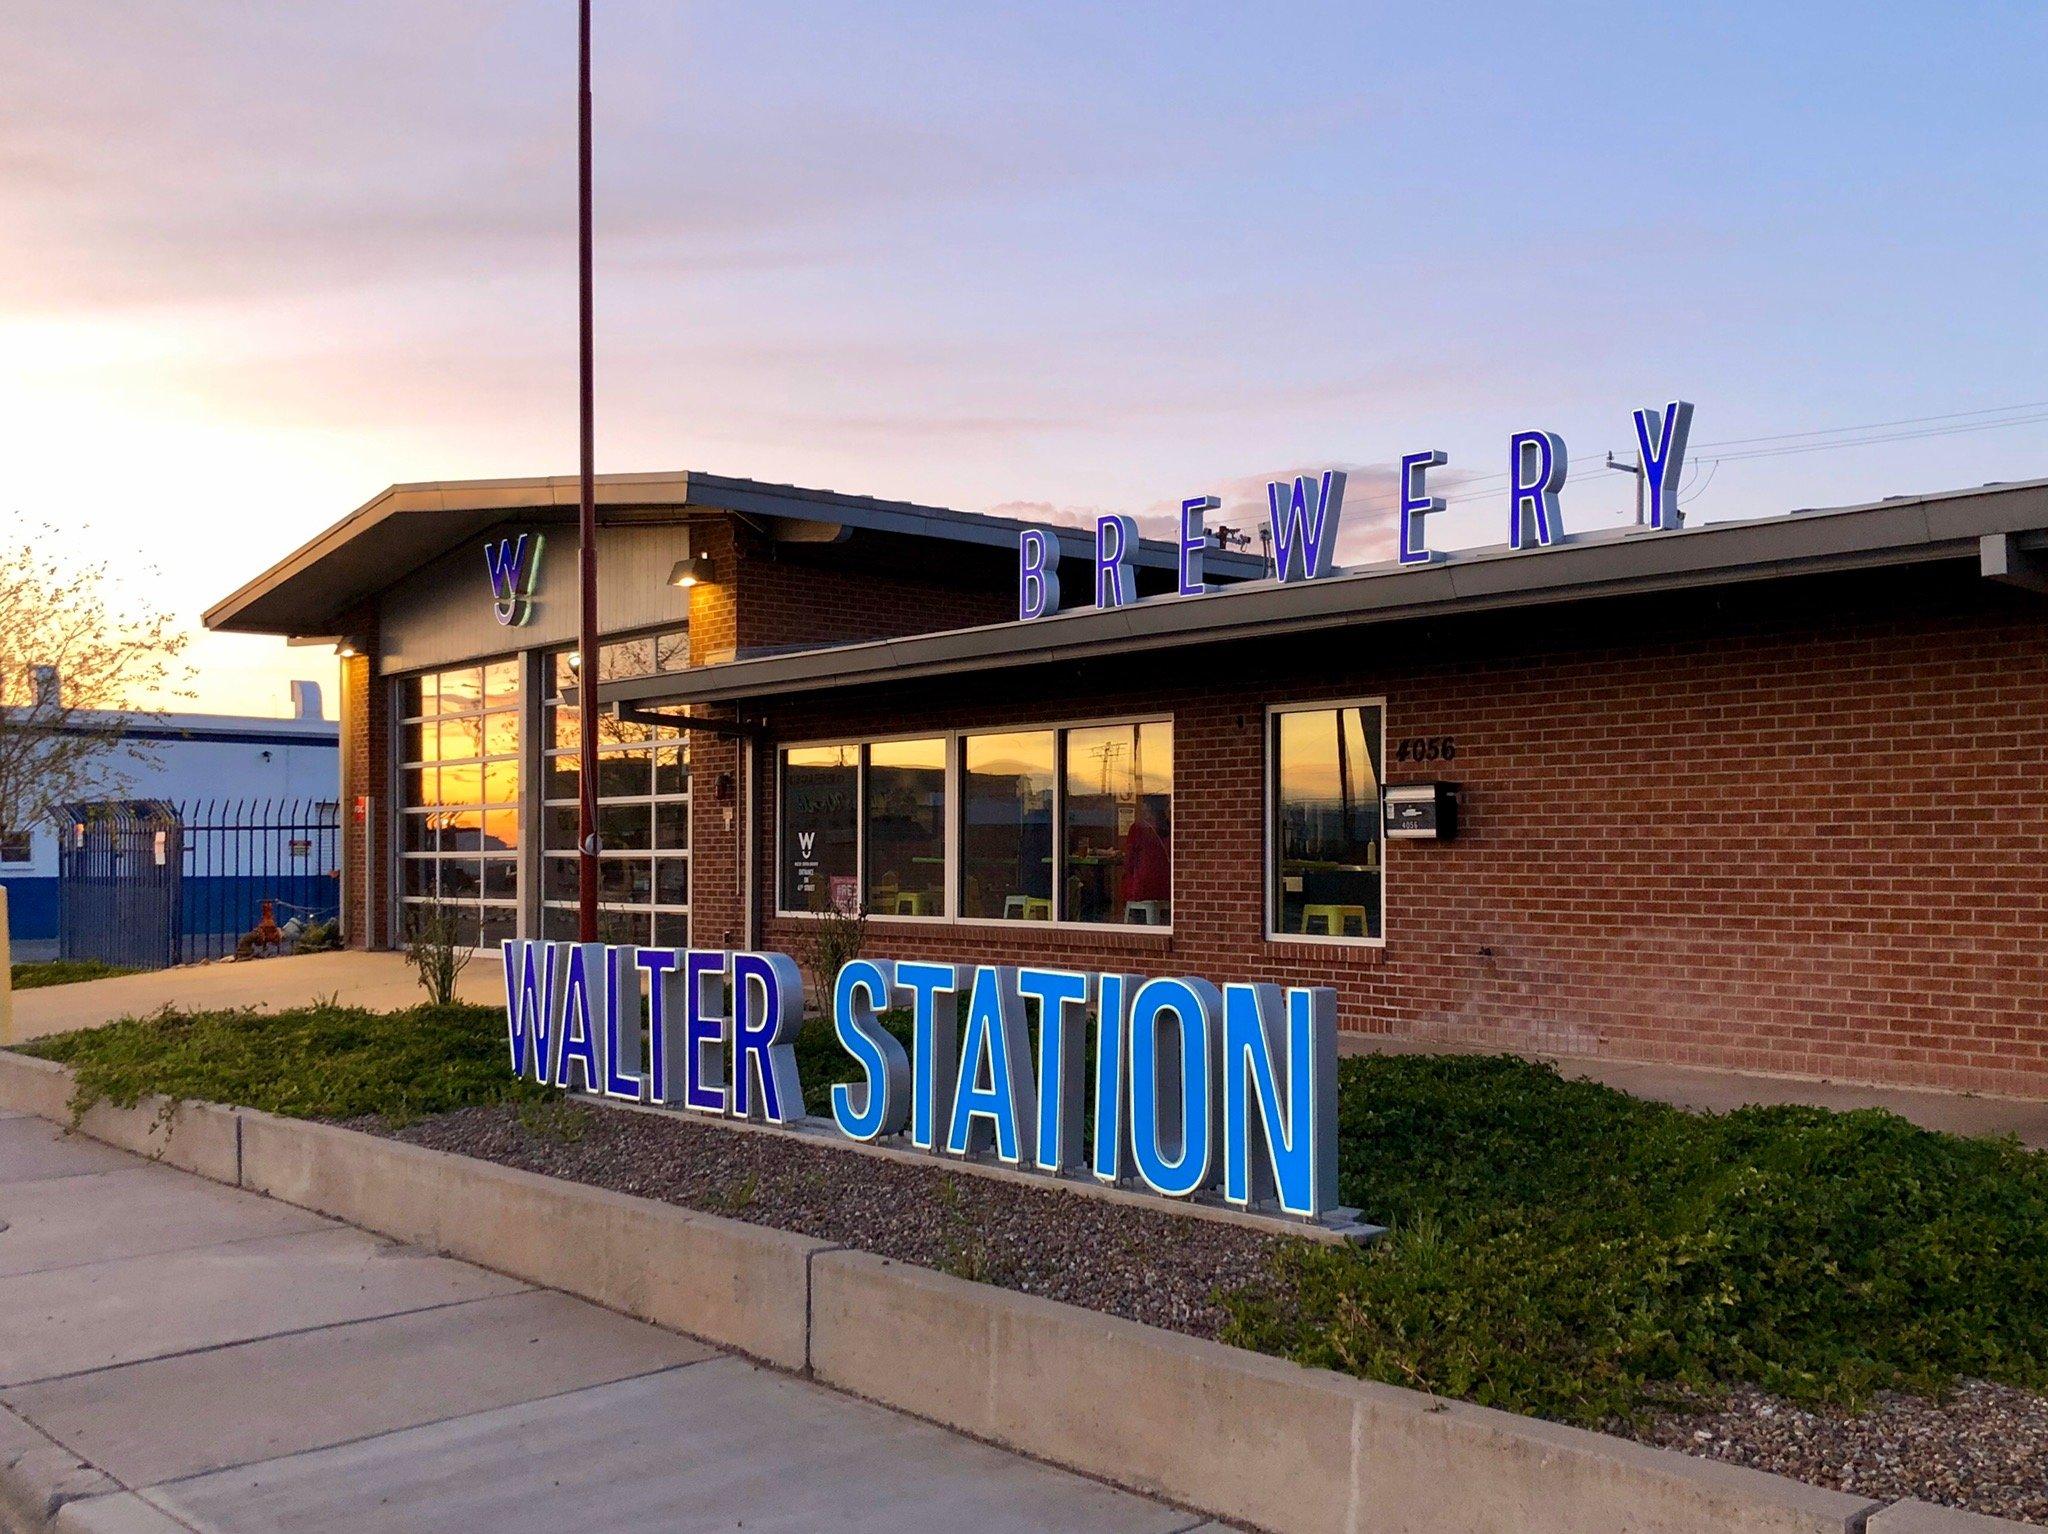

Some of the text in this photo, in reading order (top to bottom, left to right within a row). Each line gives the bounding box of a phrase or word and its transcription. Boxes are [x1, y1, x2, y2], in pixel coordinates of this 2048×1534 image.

[1019, 401, 1694, 621] BREWERY
[1396, 736, 1455, 761] 4056
[1401, 821, 1418, 829] 4056
[501, 938, 1334, 1218] WALTER STATION
